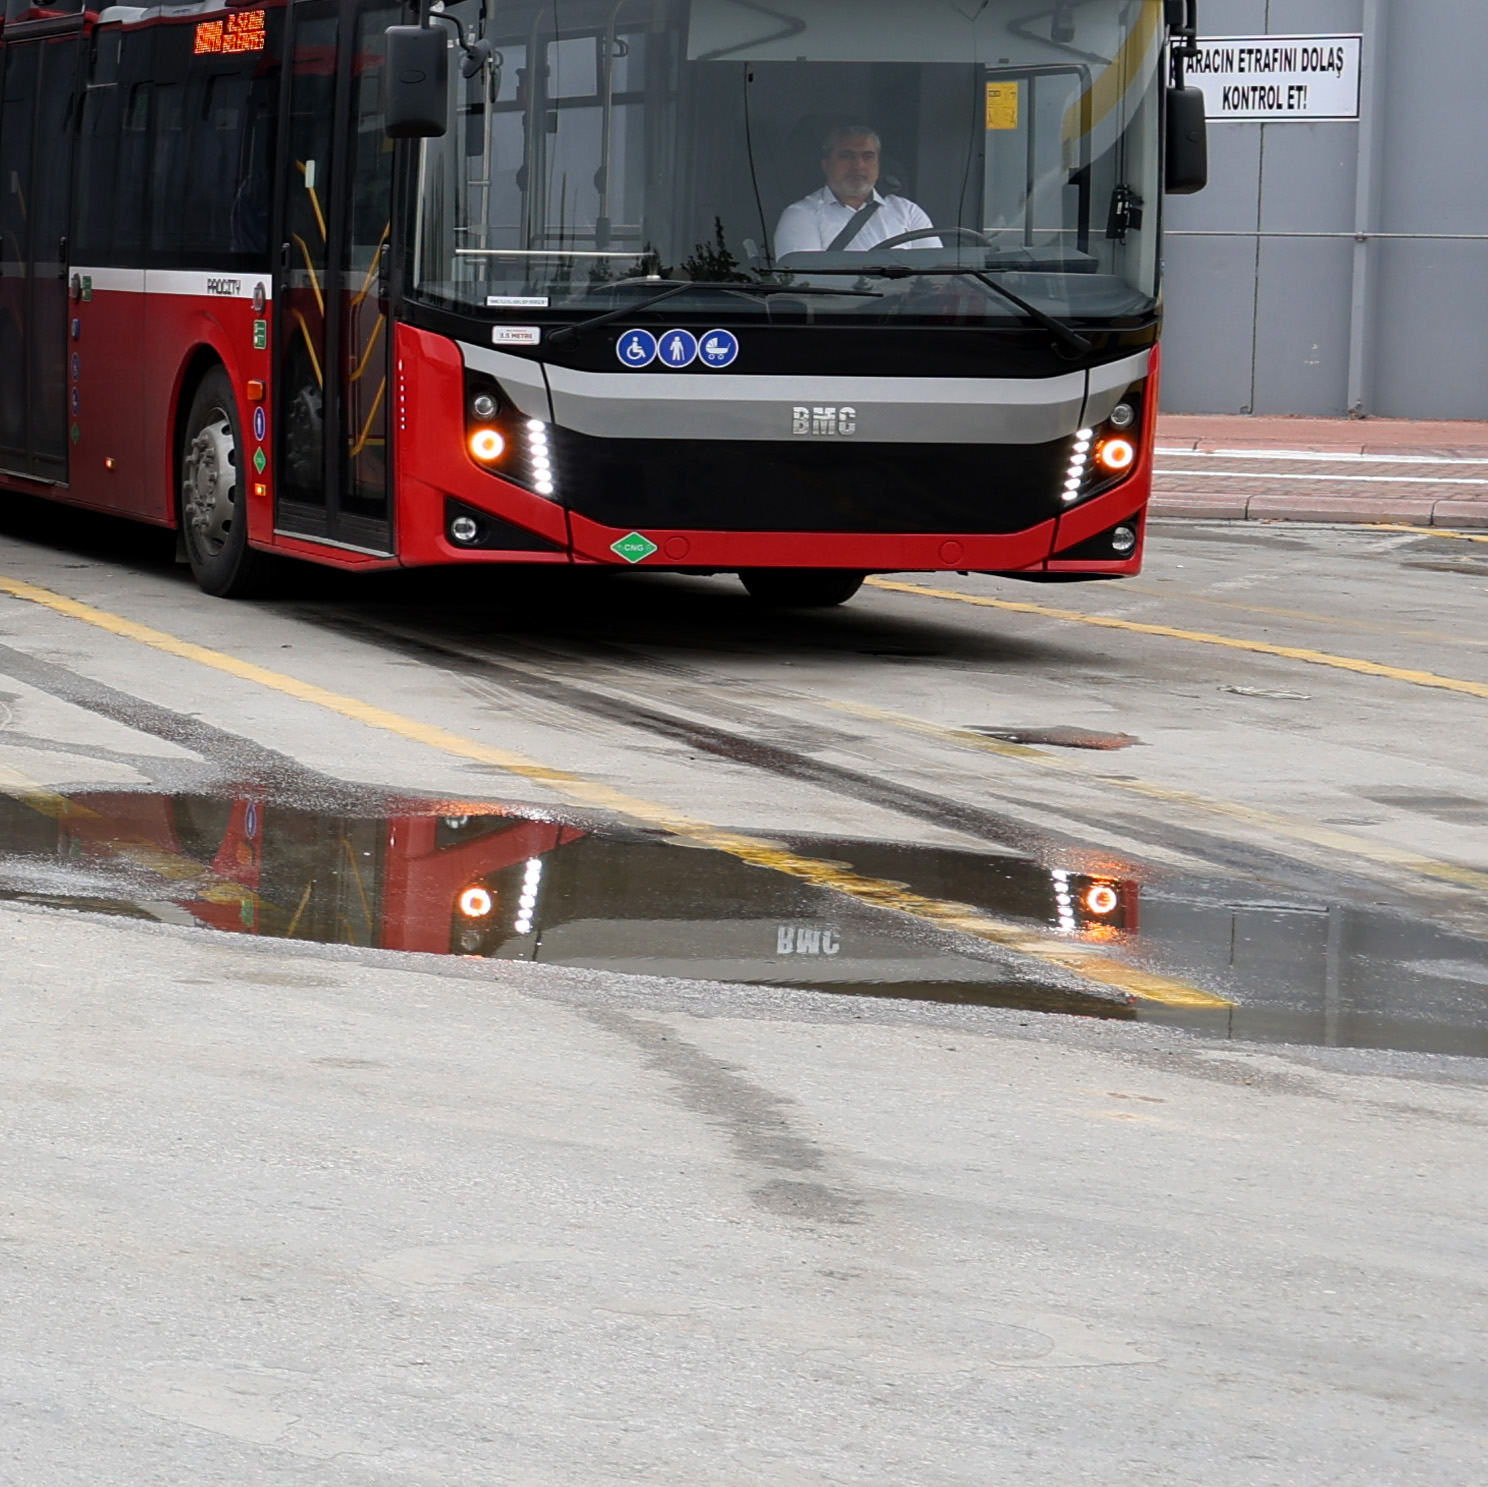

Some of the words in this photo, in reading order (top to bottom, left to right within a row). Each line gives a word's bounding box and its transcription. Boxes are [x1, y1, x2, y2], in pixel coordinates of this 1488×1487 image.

[1186, 49, 1234, 73] ARACIN
[1238, 48, 1297, 73] ETRAFINI
[1301, 47, 1344, 78] DOLAŞ
[1222, 85, 1283, 111] KONTROL
[1287, 85, 1307, 110] ET!
[792, 406, 856, 436] BMC
